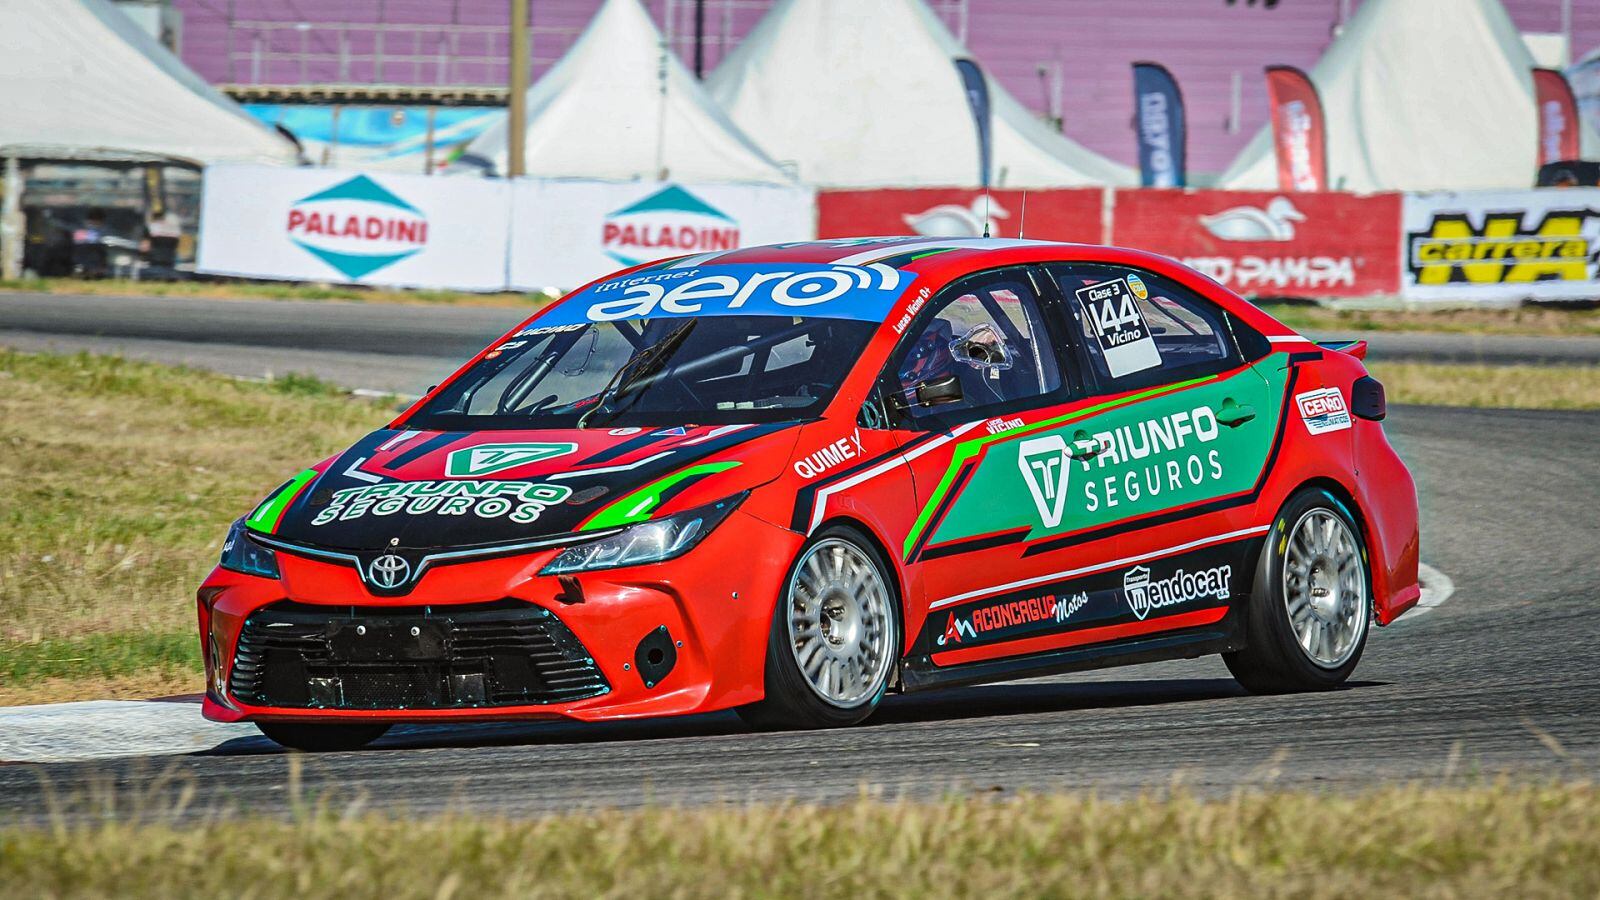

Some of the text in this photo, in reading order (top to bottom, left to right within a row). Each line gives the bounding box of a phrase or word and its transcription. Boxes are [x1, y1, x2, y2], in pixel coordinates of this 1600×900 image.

[287, 209, 428, 245] PALADINI
[602, 222, 740, 250] PALADINI
[1418, 238, 1588, 261] carrera
[586, 270, 853, 321] aero
[595, 269, 700, 295] internet
[1088, 289, 1113, 302] Clase
[1111, 283, 1121, 296] 3
[892, 313, 911, 335] Lucas
[905, 295, 925, 316] Vicino
[1088, 293, 1140, 337] 144
[1107, 329, 1142, 346] Vicino
[986, 417, 1026, 435] VICINO
[1074, 405, 1220, 472] TRIUNFO
[332, 480, 573, 505] TRIUNFO
[1084, 449, 1223, 512] SEGUROS
[311, 496, 545, 525] SEGUROS
[1051, 591, 1089, 623] Motos
